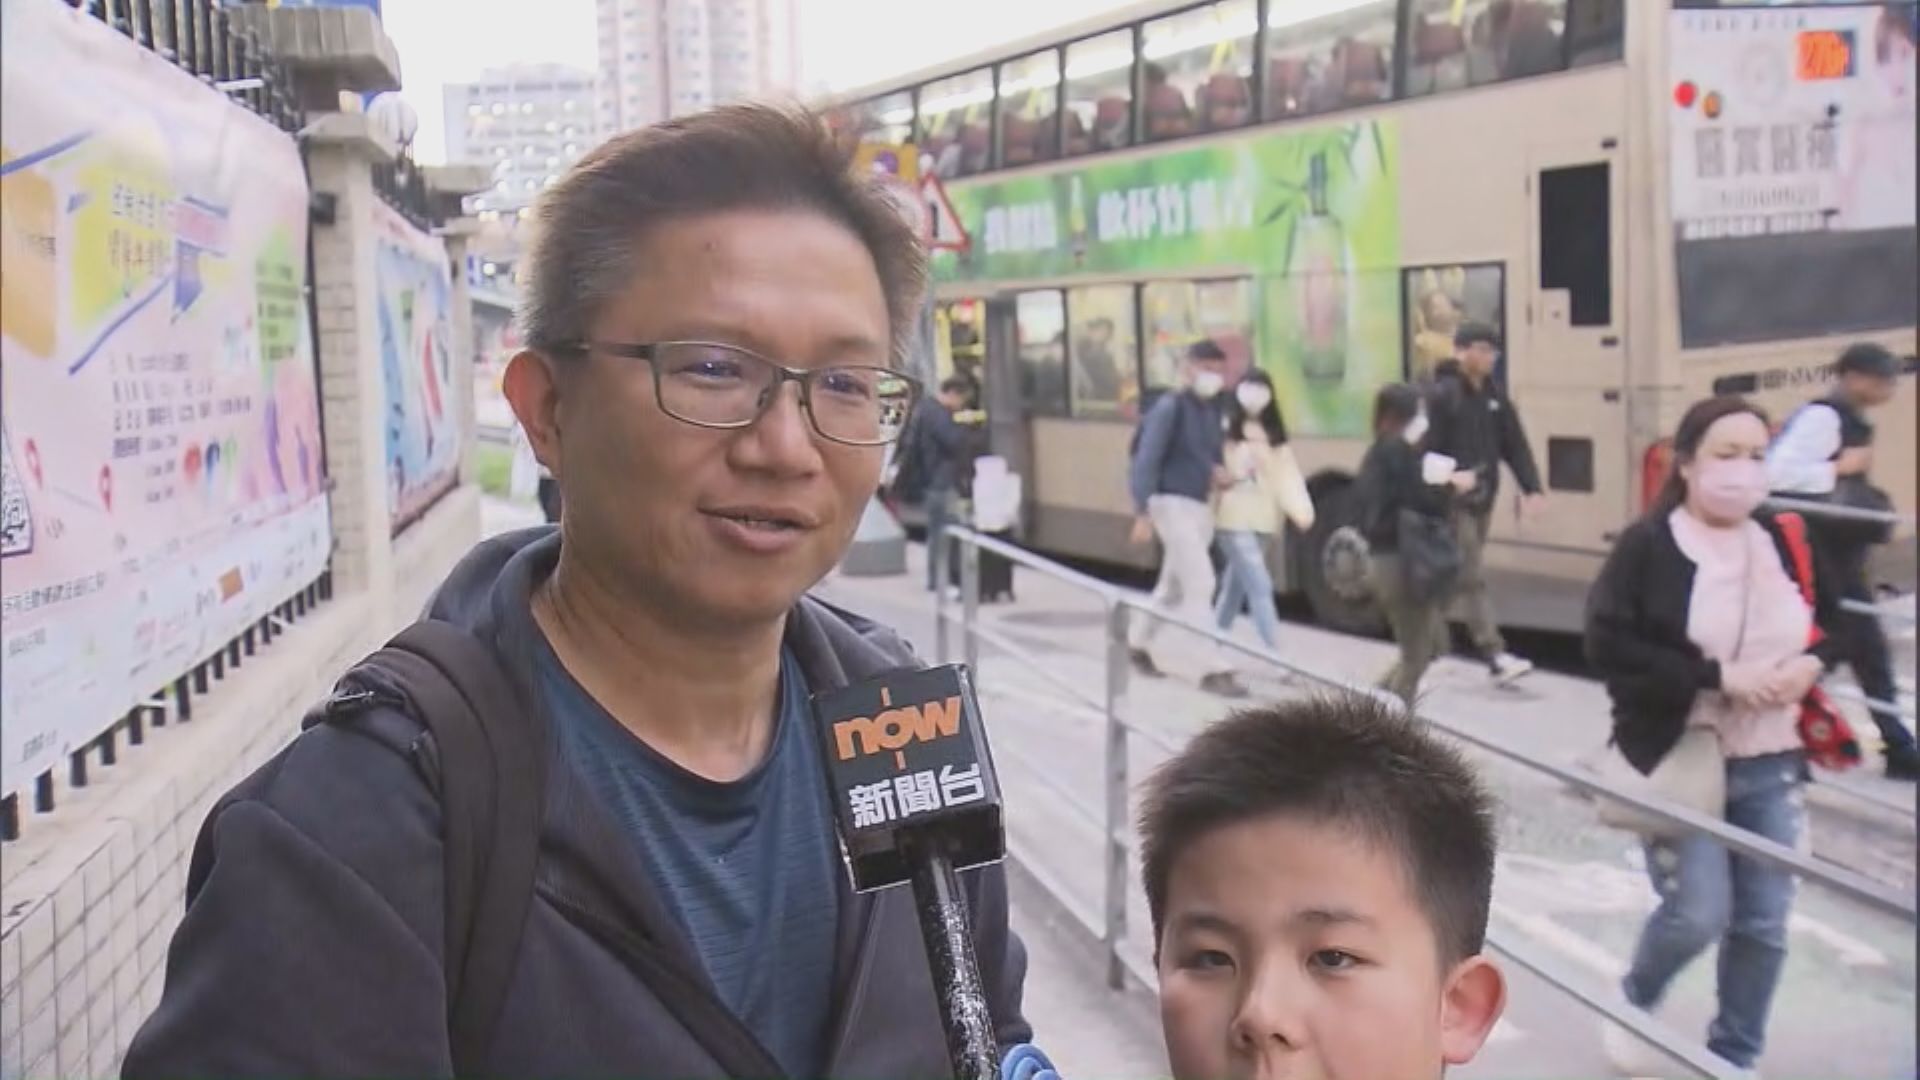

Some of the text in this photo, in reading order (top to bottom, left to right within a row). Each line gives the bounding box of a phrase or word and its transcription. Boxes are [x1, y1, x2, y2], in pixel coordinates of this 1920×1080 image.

[834, 696, 962, 760] now
[849, 763, 985, 828] 新聞台
